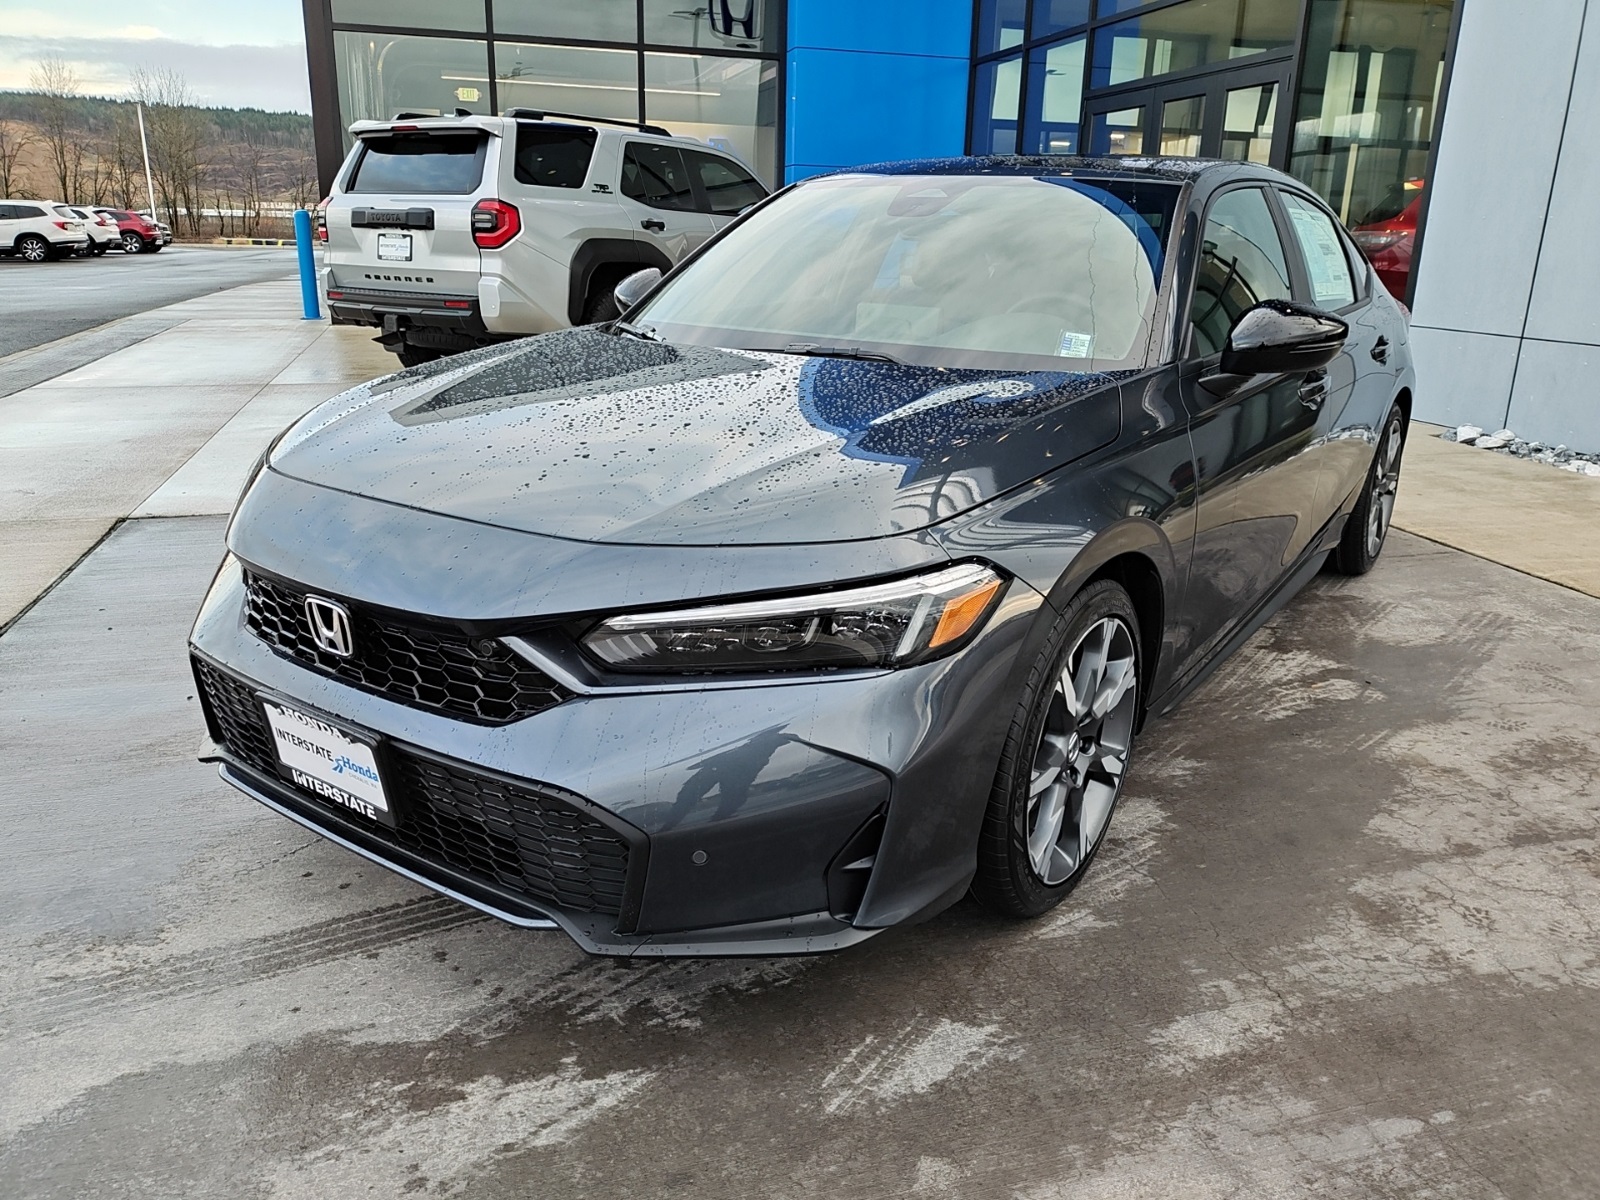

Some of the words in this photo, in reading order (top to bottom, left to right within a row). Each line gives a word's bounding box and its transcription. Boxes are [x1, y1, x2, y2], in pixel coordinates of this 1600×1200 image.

[462, 89, 475, 99] EXIT
[370, 213, 401, 221] TOYOTA
[364, 273, 434, 283] 4RUNNER
[280, 705, 345, 740] HONDA
[275, 727, 334, 762] INTERSTATE
[340, 756, 379, 782] Honda
[292, 769, 377, 820] INTERSTATE
